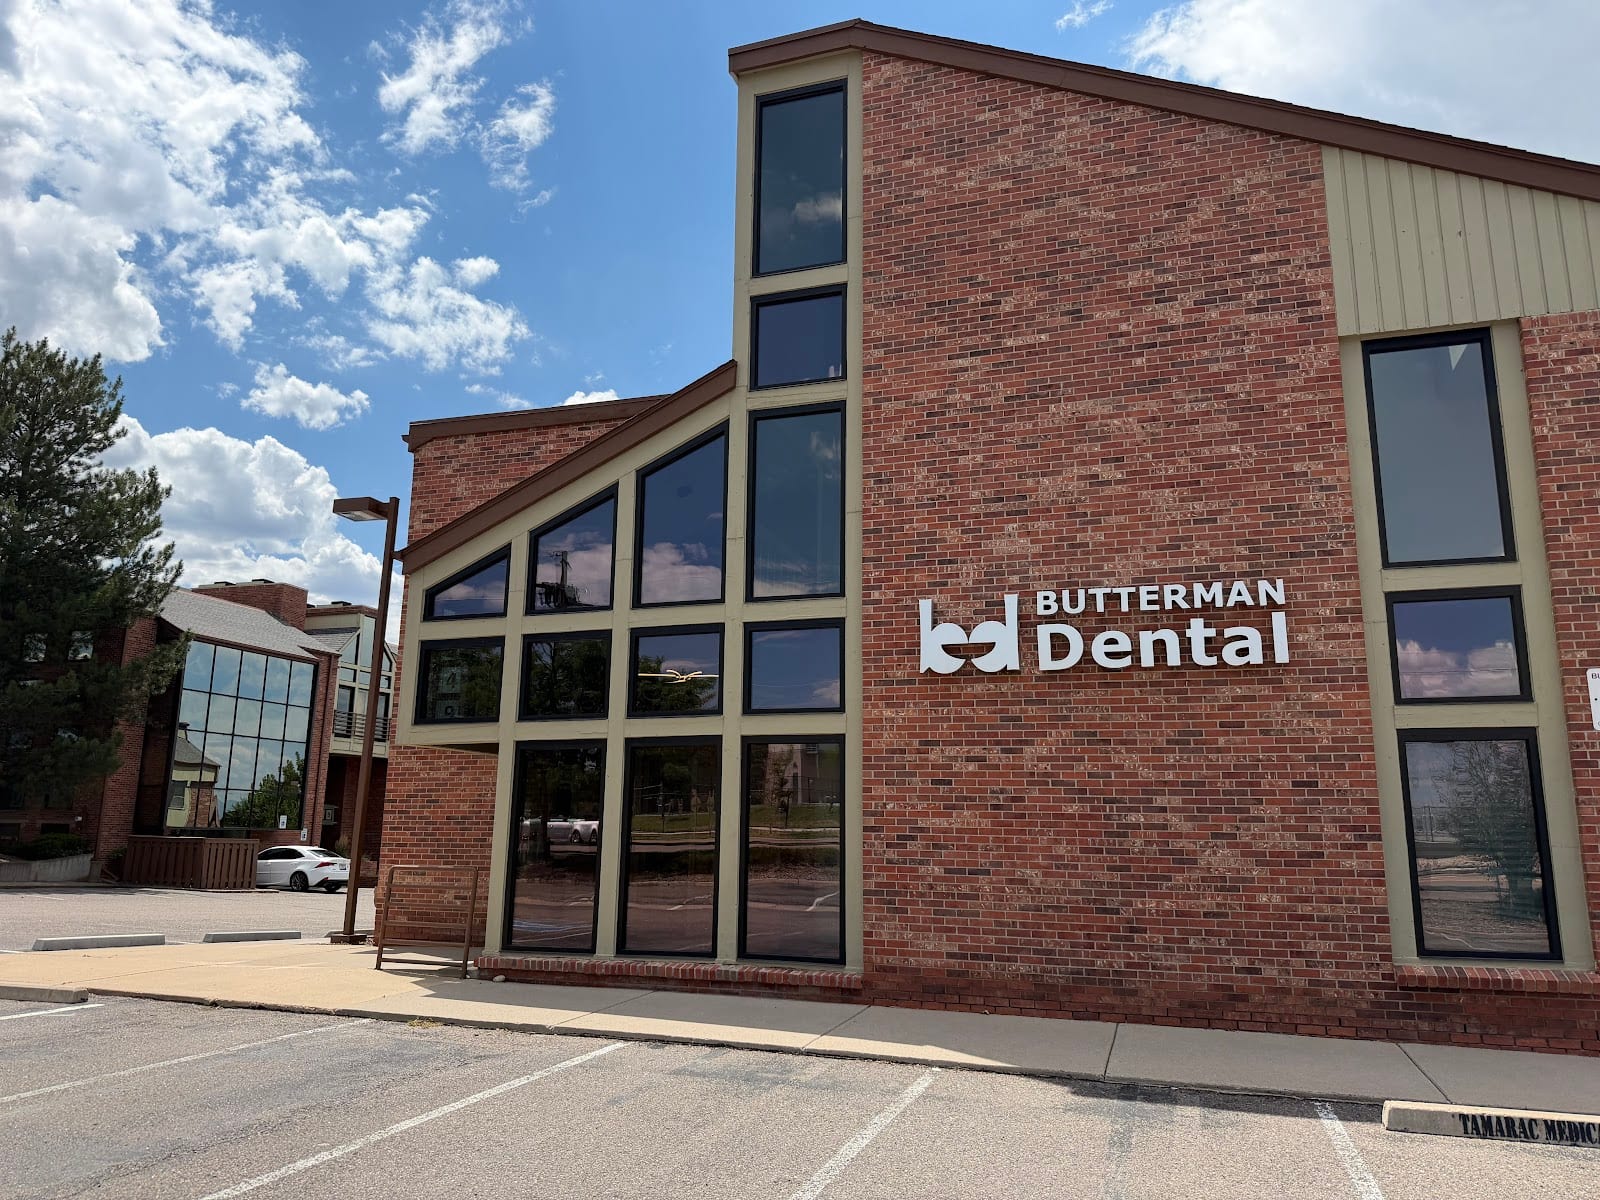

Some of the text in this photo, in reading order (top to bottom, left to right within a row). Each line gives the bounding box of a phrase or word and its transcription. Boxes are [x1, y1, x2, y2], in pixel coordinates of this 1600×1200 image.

[1036, 578, 1286, 615] BUTTERMAN
[919, 593, 1020, 674] bd
[1036, 611, 1290, 671] Dental
[1459, 1113, 1600, 1145] TAMARAC MEDIC
